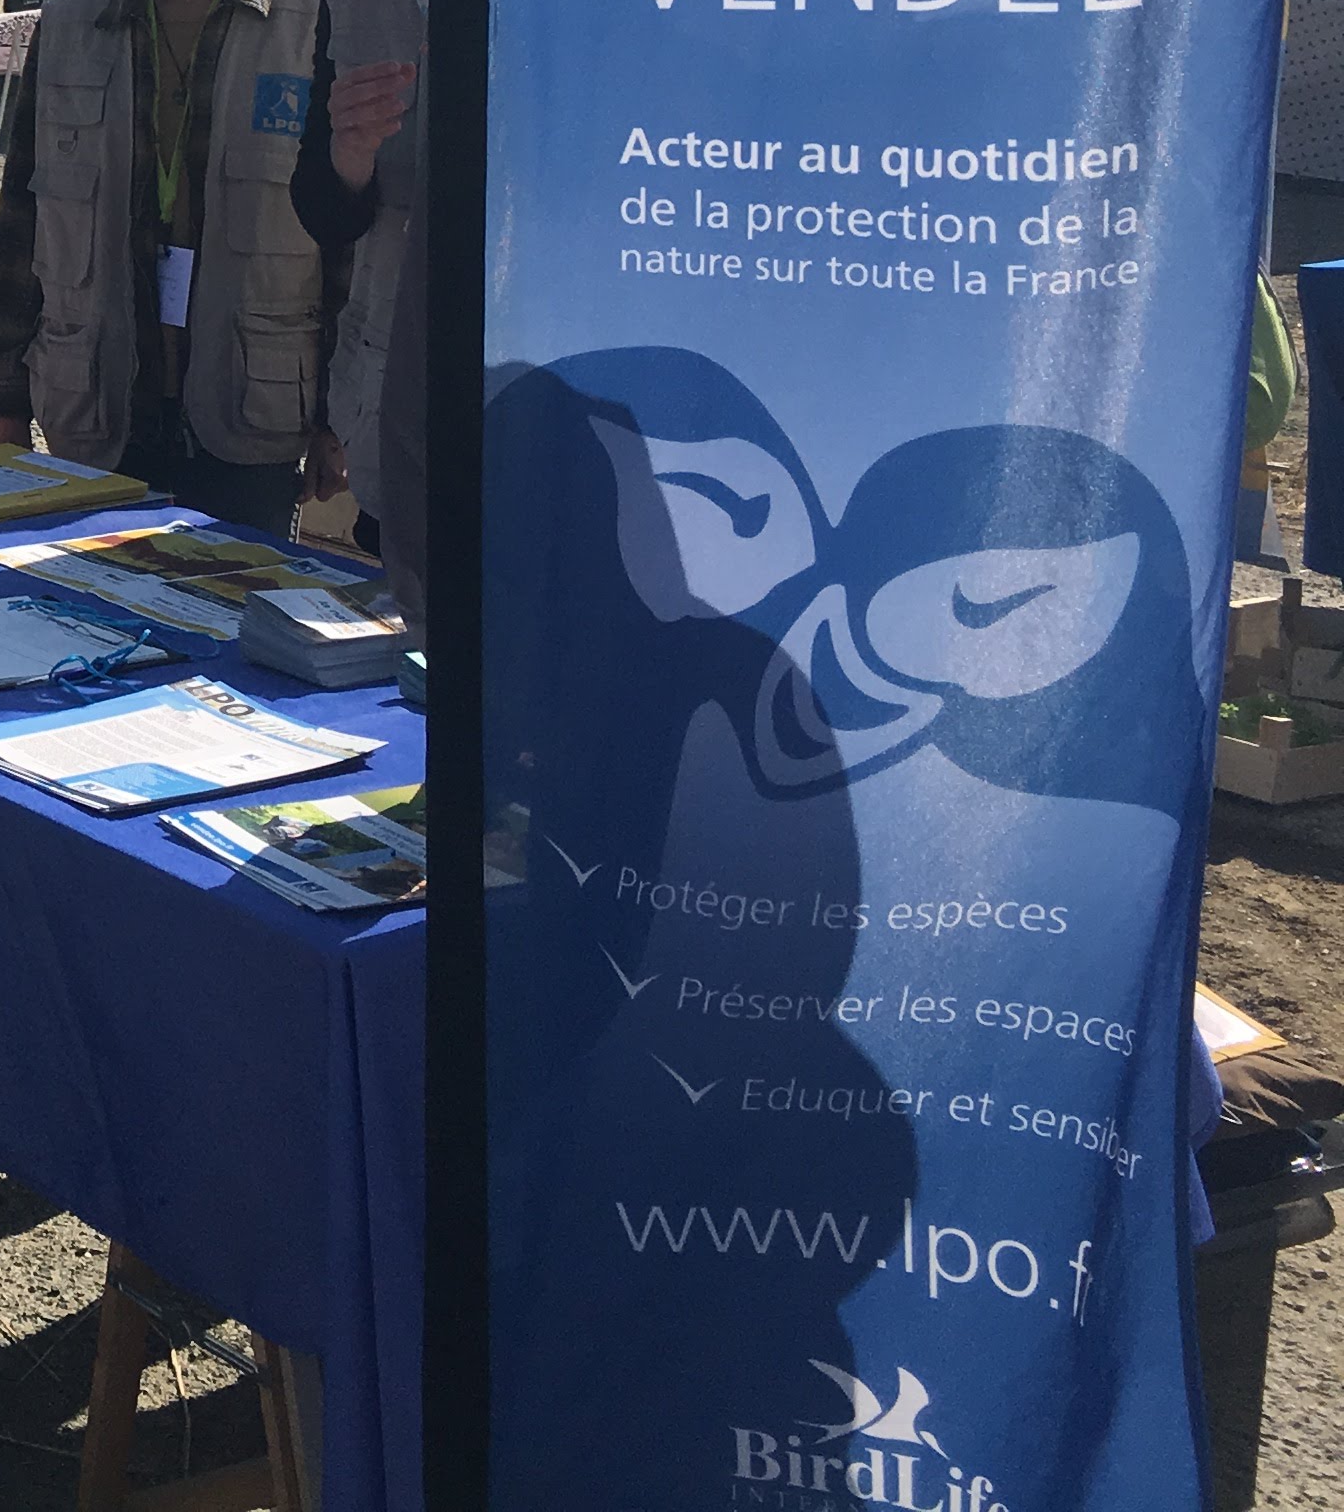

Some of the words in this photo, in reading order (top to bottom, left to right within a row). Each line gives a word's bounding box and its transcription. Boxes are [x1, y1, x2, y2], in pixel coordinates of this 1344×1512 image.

[262, 117, 302, 132] LPO
[620, 127, 782, 171] Acteur
[798, 142, 860, 176] au
[881, 137, 1140, 189] quotidien
[620, 187, 676, 227] de
[694, 189, 730, 229] la
[746, 197, 998, 245] protection
[1019, 205, 1083, 246] de
[1102, 199, 1139, 239] la
[620, 246, 743, 280] nature
[755, 255, 814, 284] sur
[827, 256, 936, 294] toute
[953, 261, 988, 296] la
[1007, 261, 1140, 297] France
[616, 865, 796, 931] Protéger
[812, 891, 869, 930] les
[886, 892, 1069, 937] espèces
[676, 976, 884, 1024] Préserver
[897, 985, 957, 1025] les
[974, 998, 1136, 1057] espaces
[740, 1078, 933, 1121] Eduquer
[948, 1090, 994, 1127] et
[728, 1426, 1011, 1512] BirdLif
